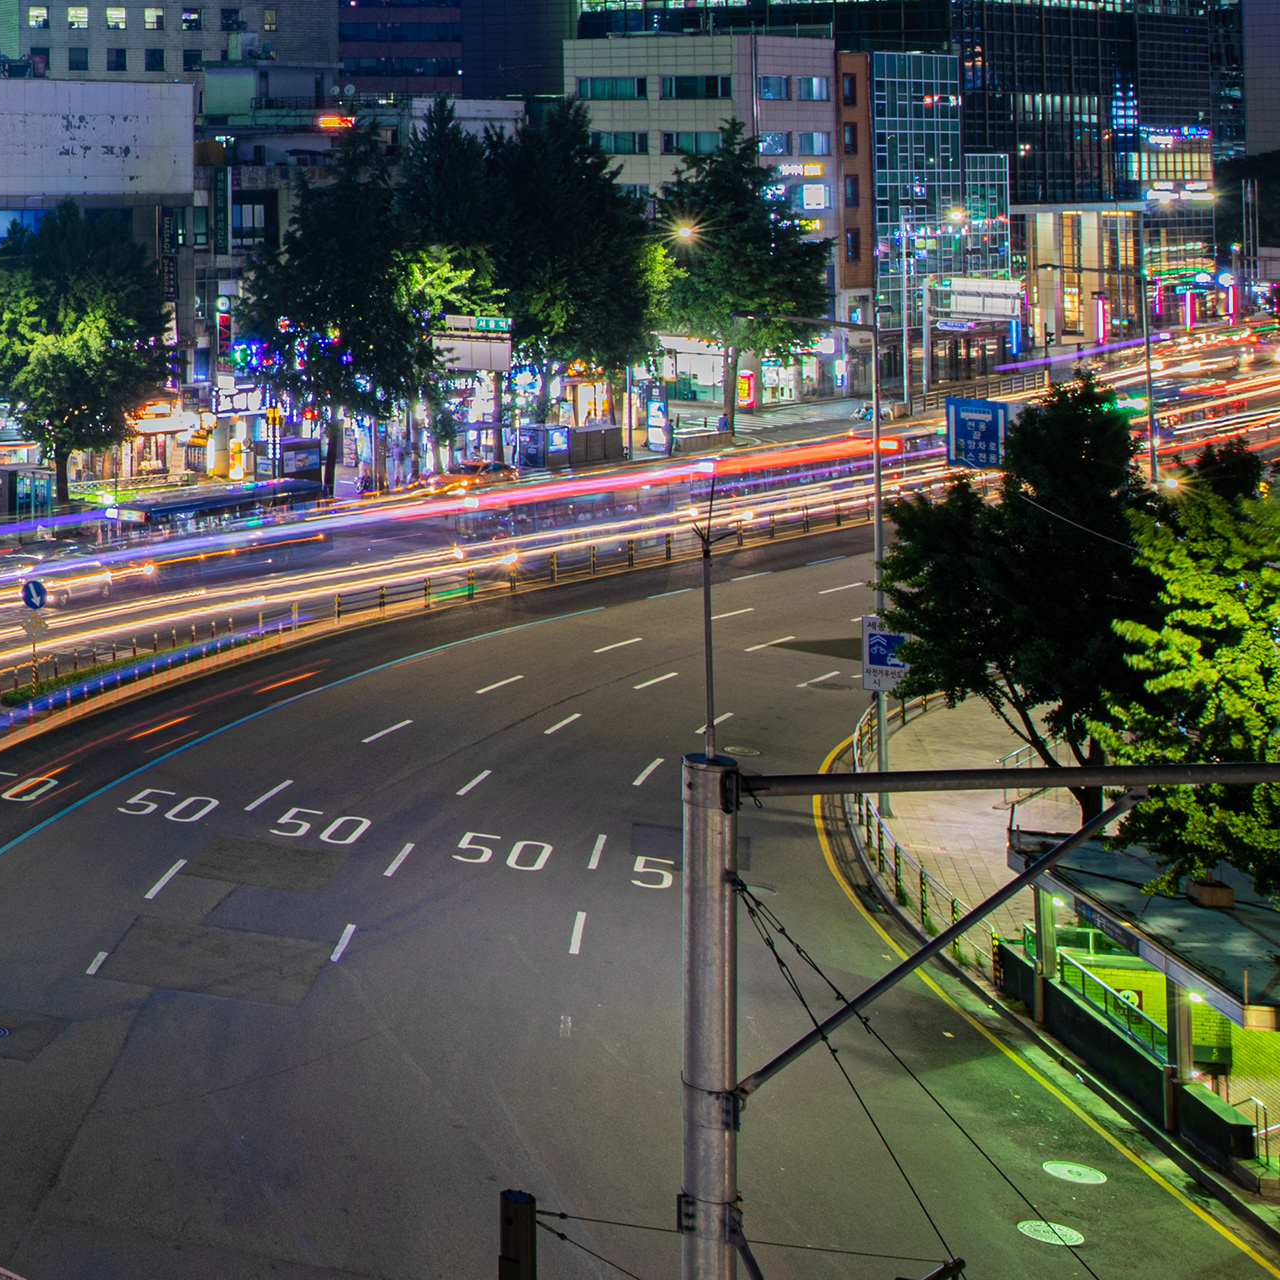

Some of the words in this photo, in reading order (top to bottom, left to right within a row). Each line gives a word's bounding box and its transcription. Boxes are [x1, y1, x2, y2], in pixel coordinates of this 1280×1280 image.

[219, 314, 231, 355] BAR
[478, 320, 507, 330] 서울역
[117, 787, 220, 823] 50
[269, 807, 372, 846] 50
[452, 832, 553, 872] 50
[631, 856, 675, 889] 5
